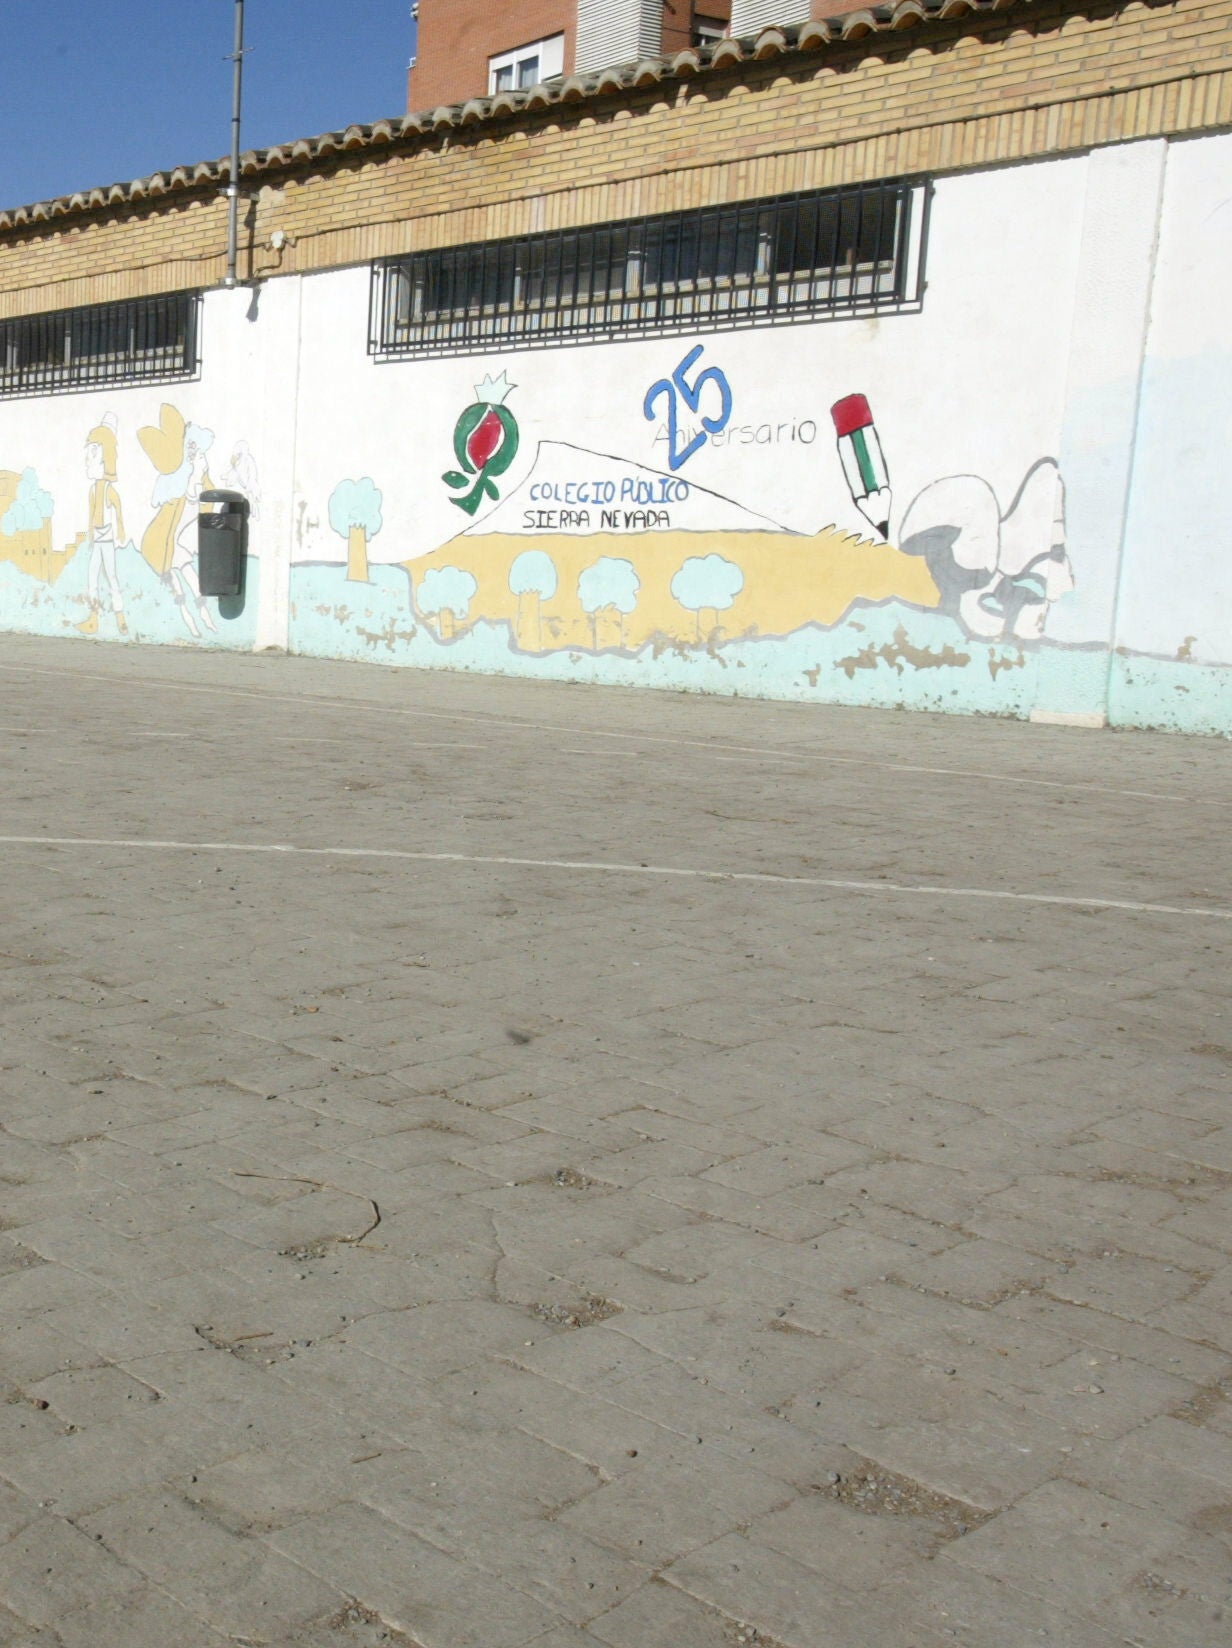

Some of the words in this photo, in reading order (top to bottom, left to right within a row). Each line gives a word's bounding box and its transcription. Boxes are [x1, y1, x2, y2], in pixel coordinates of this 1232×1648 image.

[643, 344, 733, 471] 25
[530, 481, 616, 504] COLEGIO
[522, 510, 590, 528] SIERRA
[600, 510, 670, 529] NEVADA
